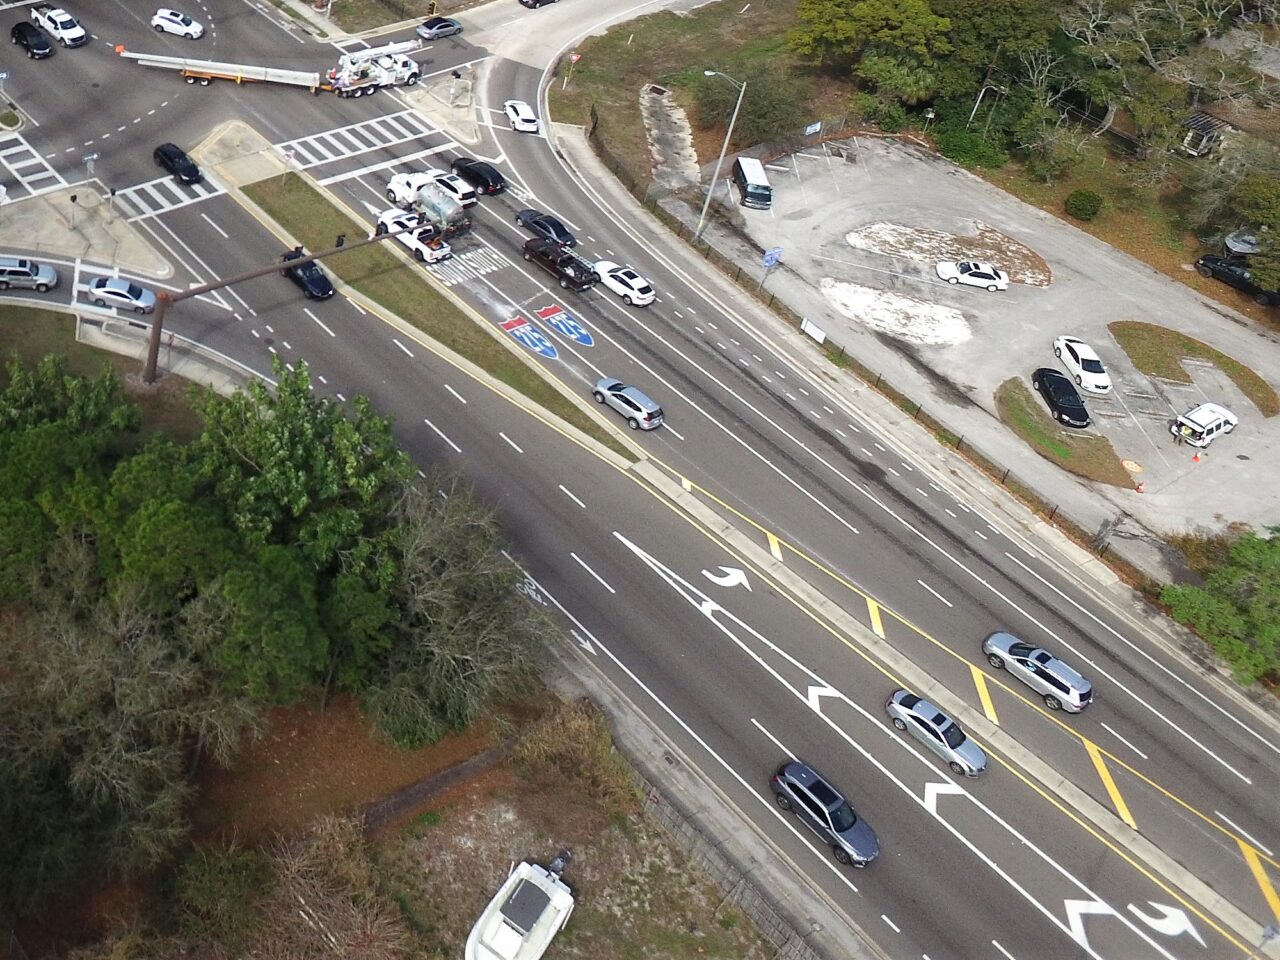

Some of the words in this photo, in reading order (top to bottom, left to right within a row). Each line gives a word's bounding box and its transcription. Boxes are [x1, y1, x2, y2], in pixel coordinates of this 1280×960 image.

[425, 257, 476, 287] SOUTH
[460, 246, 510, 275] SOUTH
[514, 325, 551, 352] 275
[551, 313, 588, 339] 275
